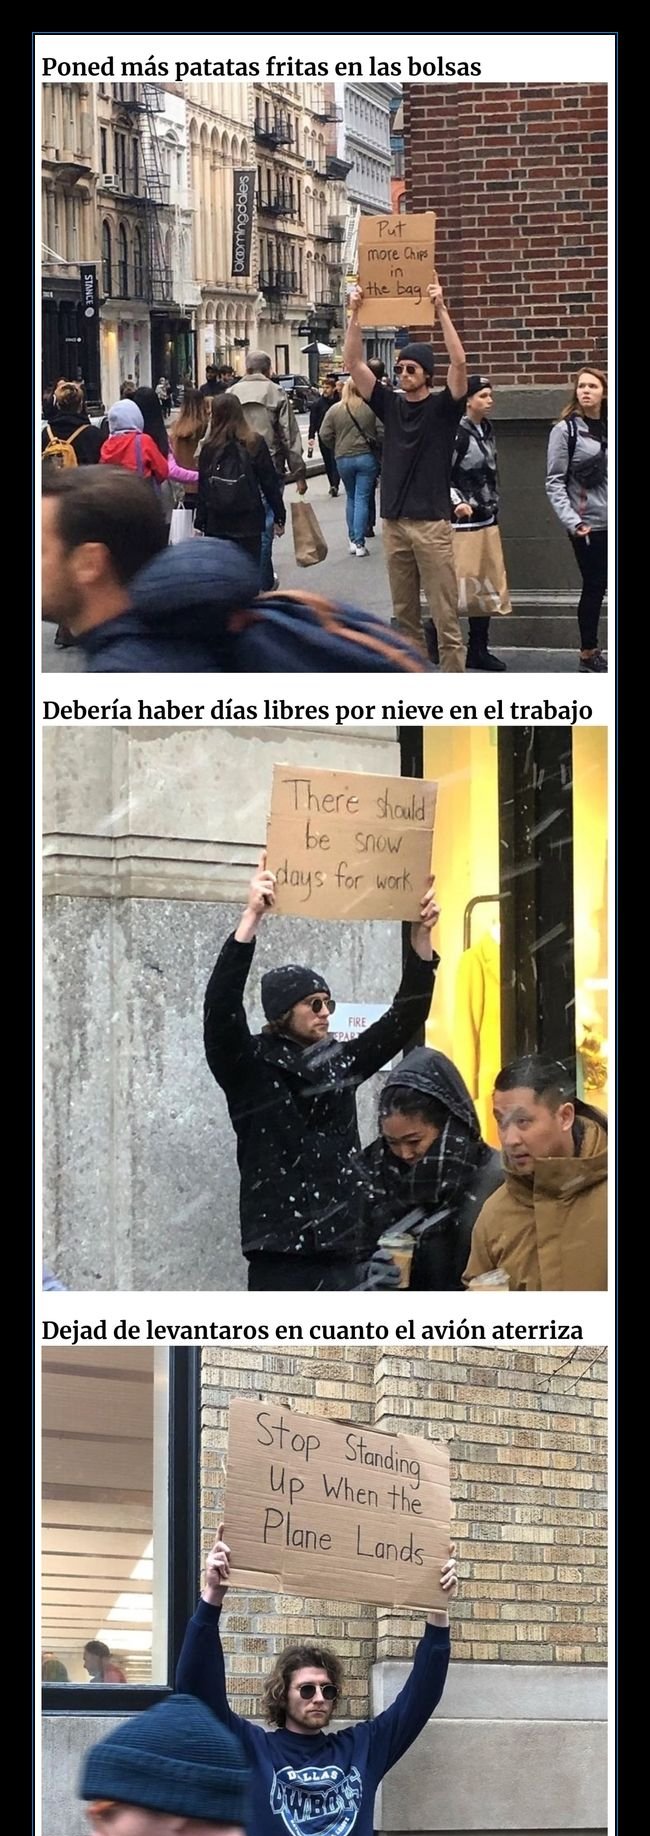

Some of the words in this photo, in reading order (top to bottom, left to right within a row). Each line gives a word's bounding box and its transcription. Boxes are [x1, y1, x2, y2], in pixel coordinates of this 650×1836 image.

[376, 220, 407, 238] Put
[367, 248, 400, 261] more
[390, 265, 404, 278] in
[84, 273, 94, 305] STANCE
[366, 281, 391, 296] the
[397, 281, 422, 306] bag
[282, 779, 360, 814] There
[305, 818, 331, 850] be
[355, 831, 403, 853] snow
[275, 859, 324, 903] days
[335, 861, 364, 889] for
[376, 867, 414, 892] work
[348, 1016, 367, 1028] FIRE
[256, 1412, 321, 1463] Stop
[345, 1433, 421, 1490] Standing
[270, 1464, 305, 1505] Up
[322, 1473, 378, 1508] When
[387, 1484, 424, 1515] the
[263, 1507, 332, 1551] Plane
[357, 1524, 425, 1567] Lands
[286, 1769, 339, 1782] DLLAS
